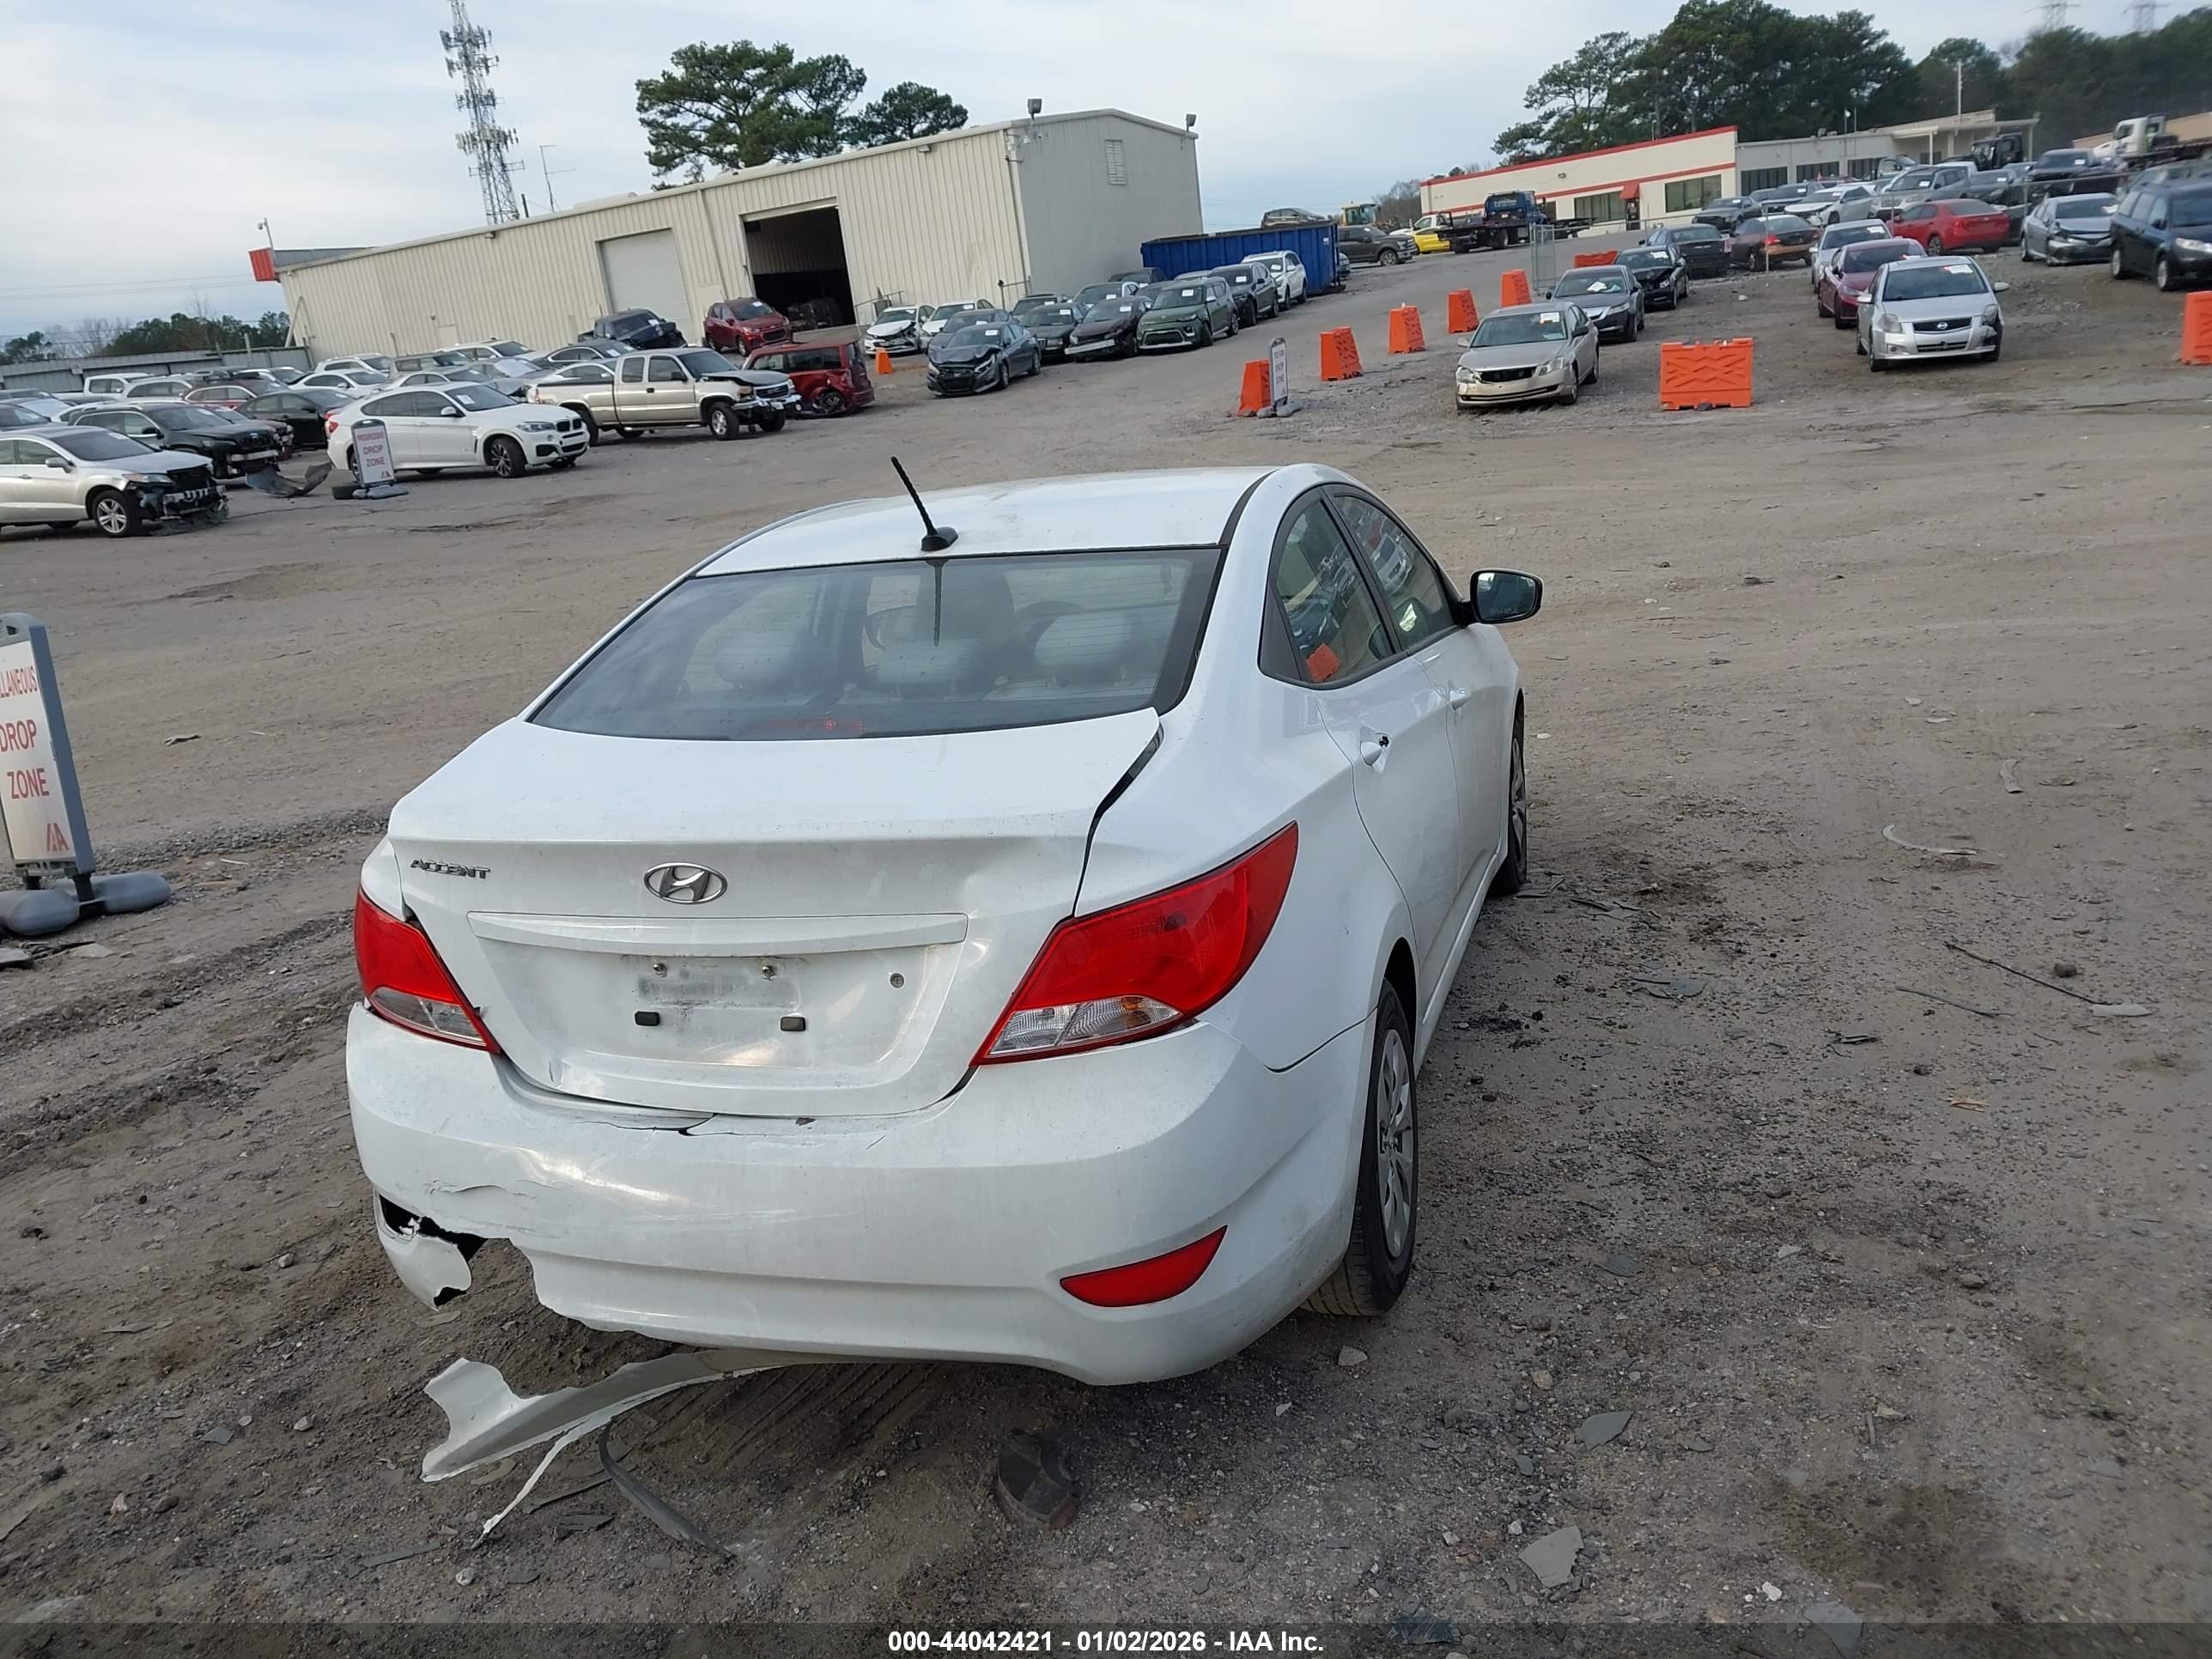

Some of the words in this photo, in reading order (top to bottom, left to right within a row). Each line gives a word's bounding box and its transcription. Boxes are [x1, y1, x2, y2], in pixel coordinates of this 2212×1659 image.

[362, 445, 384, 455] DROP
[0, 720, 37, 752] DROP
[7, 768, 50, 799] ZONE
[410, 859, 491, 879] ACCENT
